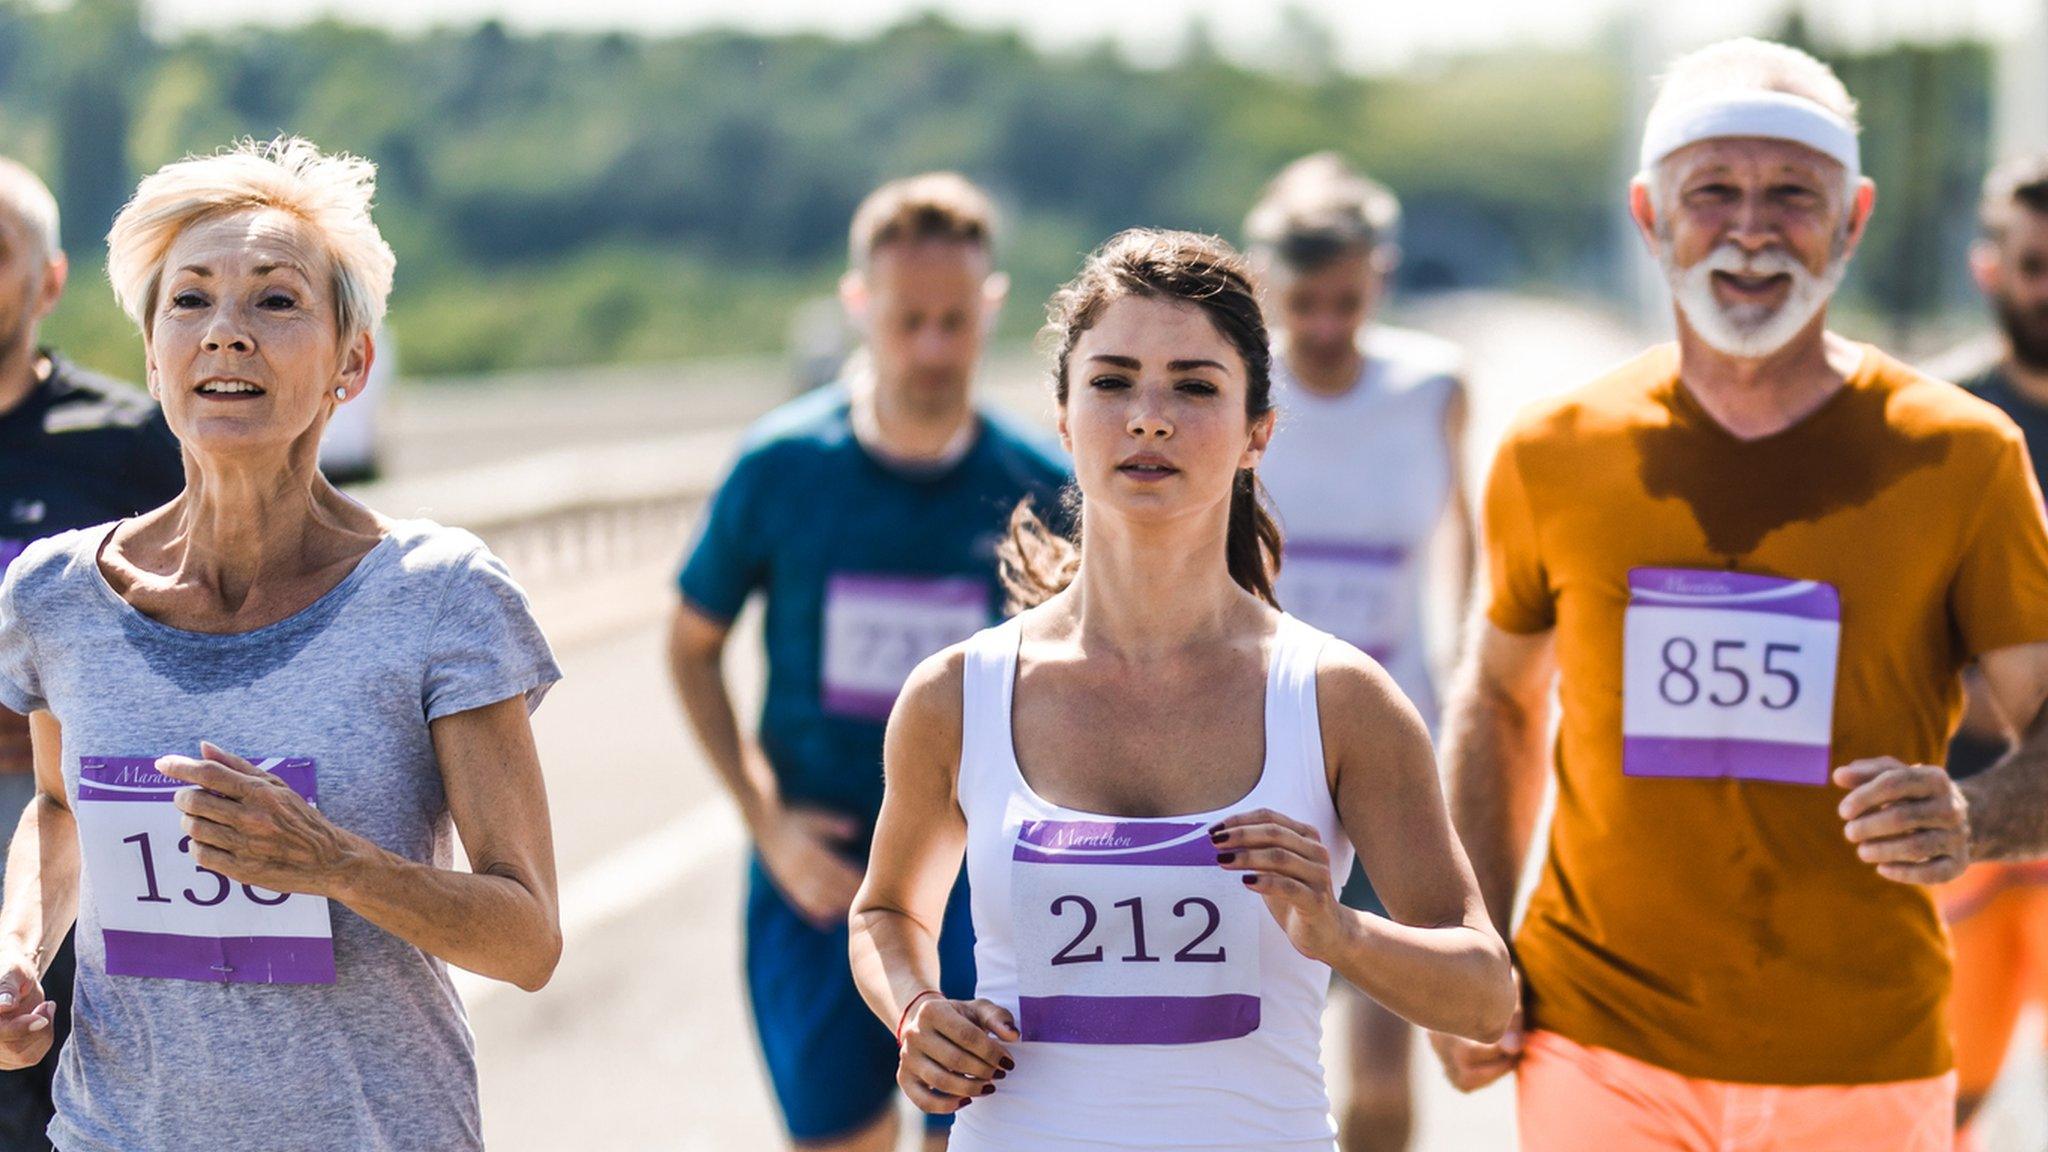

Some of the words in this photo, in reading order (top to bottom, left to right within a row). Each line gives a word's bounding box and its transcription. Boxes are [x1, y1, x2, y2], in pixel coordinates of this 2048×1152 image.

[1659, 636, 1802, 711] 855
[1048, 828, 1134, 847] Marathon
[1049, 894, 1227, 966] 212
